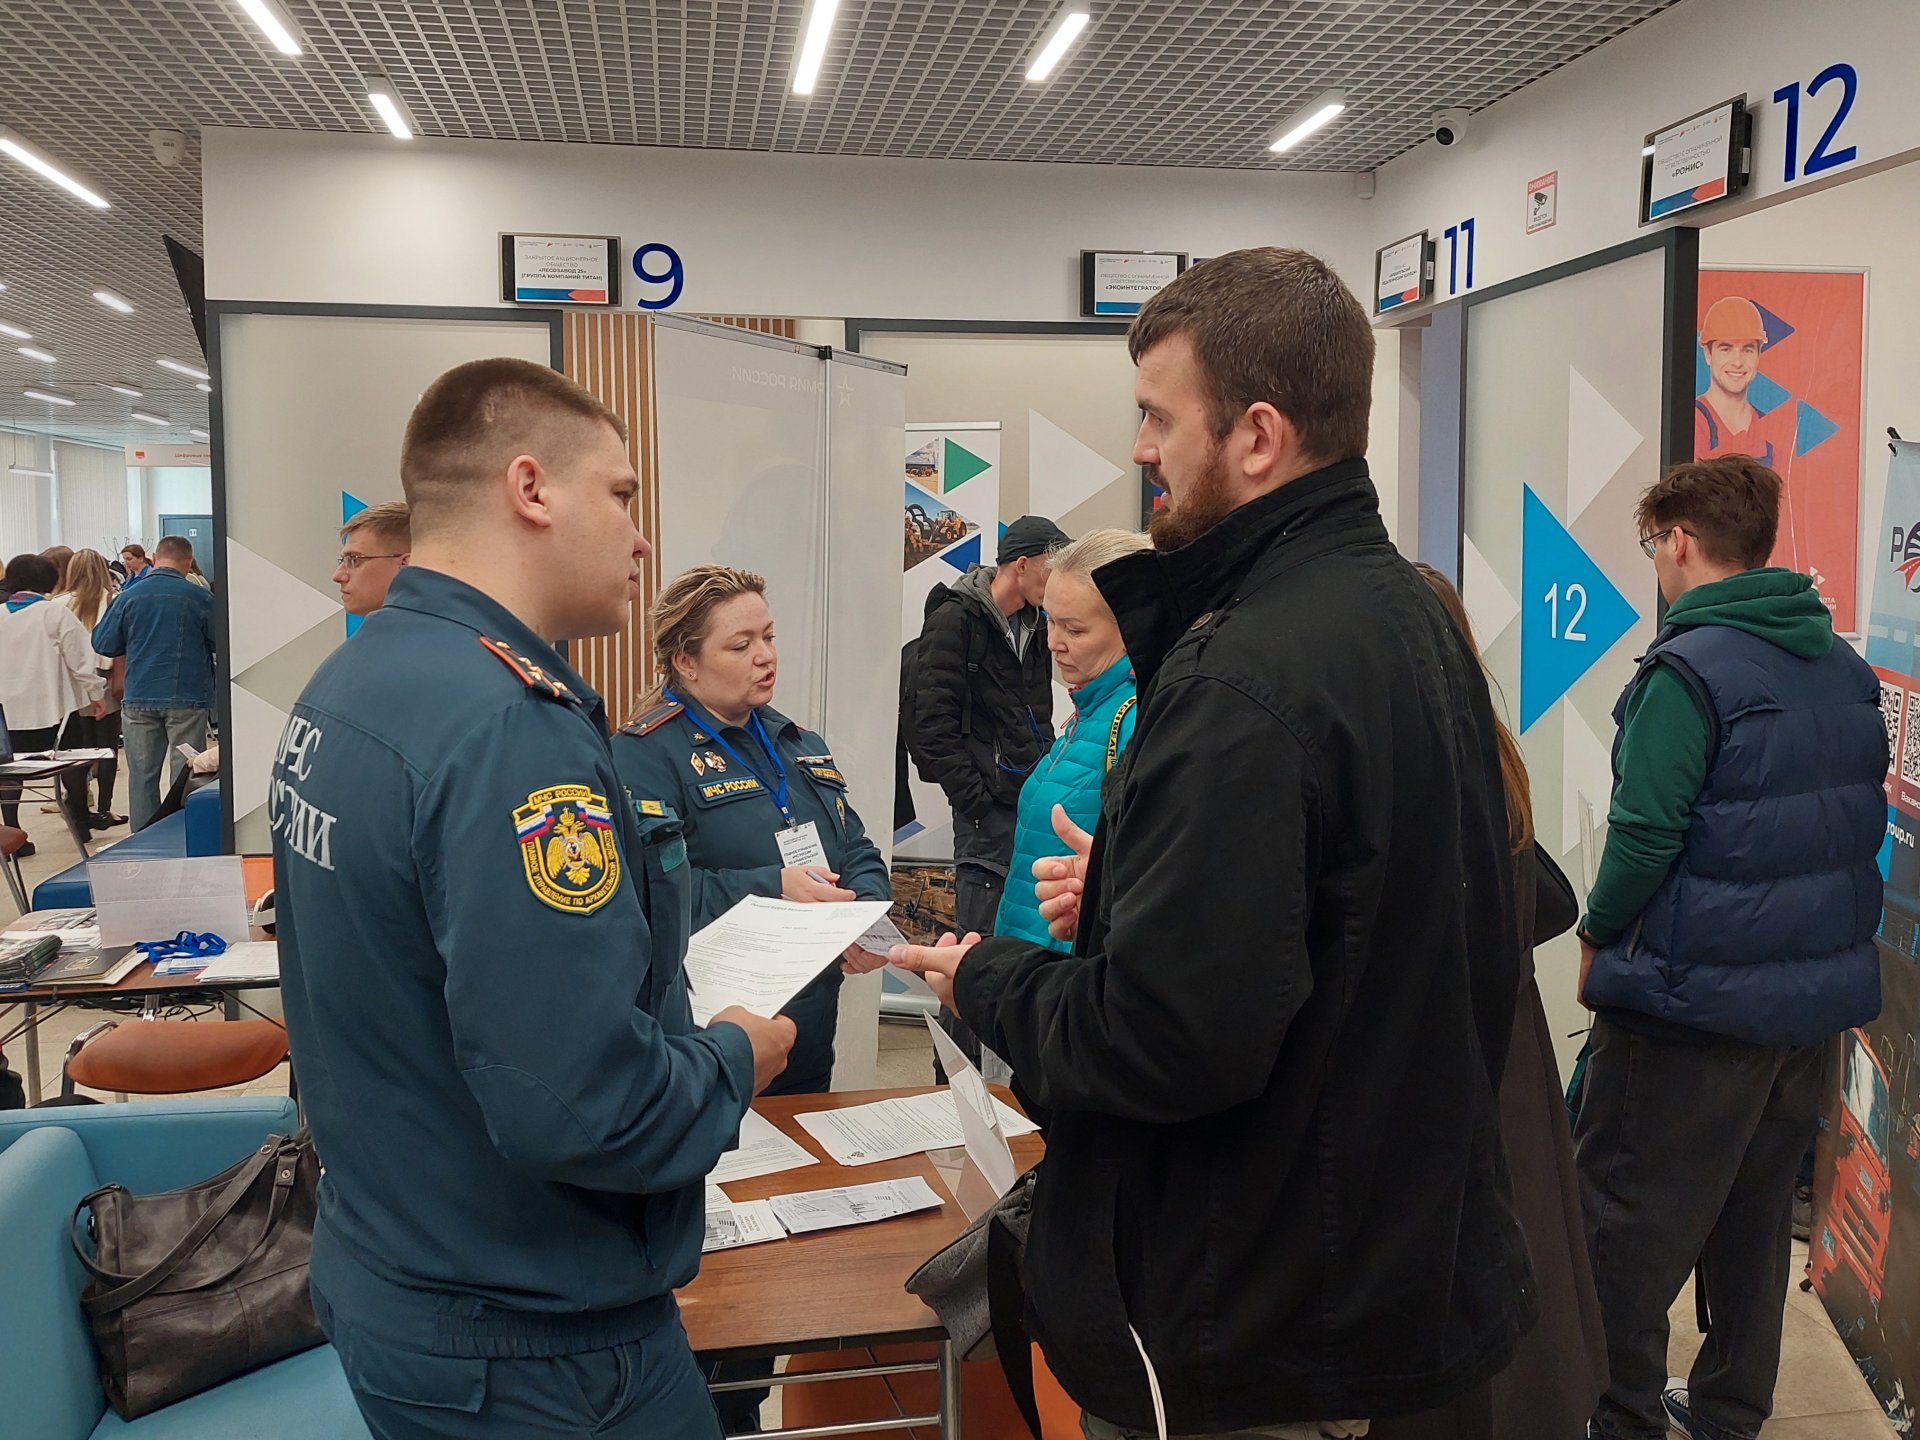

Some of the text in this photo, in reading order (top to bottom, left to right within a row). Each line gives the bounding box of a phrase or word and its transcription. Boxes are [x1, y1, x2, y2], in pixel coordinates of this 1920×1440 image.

[1773, 63, 1857, 182] 12
[1672, 161, 1704, 178] «РОНИС»
[632, 242, 684, 309] 9
[1444, 217, 1475, 295] 11
[1544, 582, 1587, 641] 12
[276, 715, 323, 782] МЧС
[533, 788, 588, 805] МЧС РОССИИ
[702, 778, 760, 798] МЧС РОССИИ
[1886, 821, 1915, 849] roup.ru
[526, 841, 539, 873] ГЛАВНОЕ
[533, 872, 571, 905] УПРАВЛЕНИЕ
[572, 897, 584, 906] ПО
